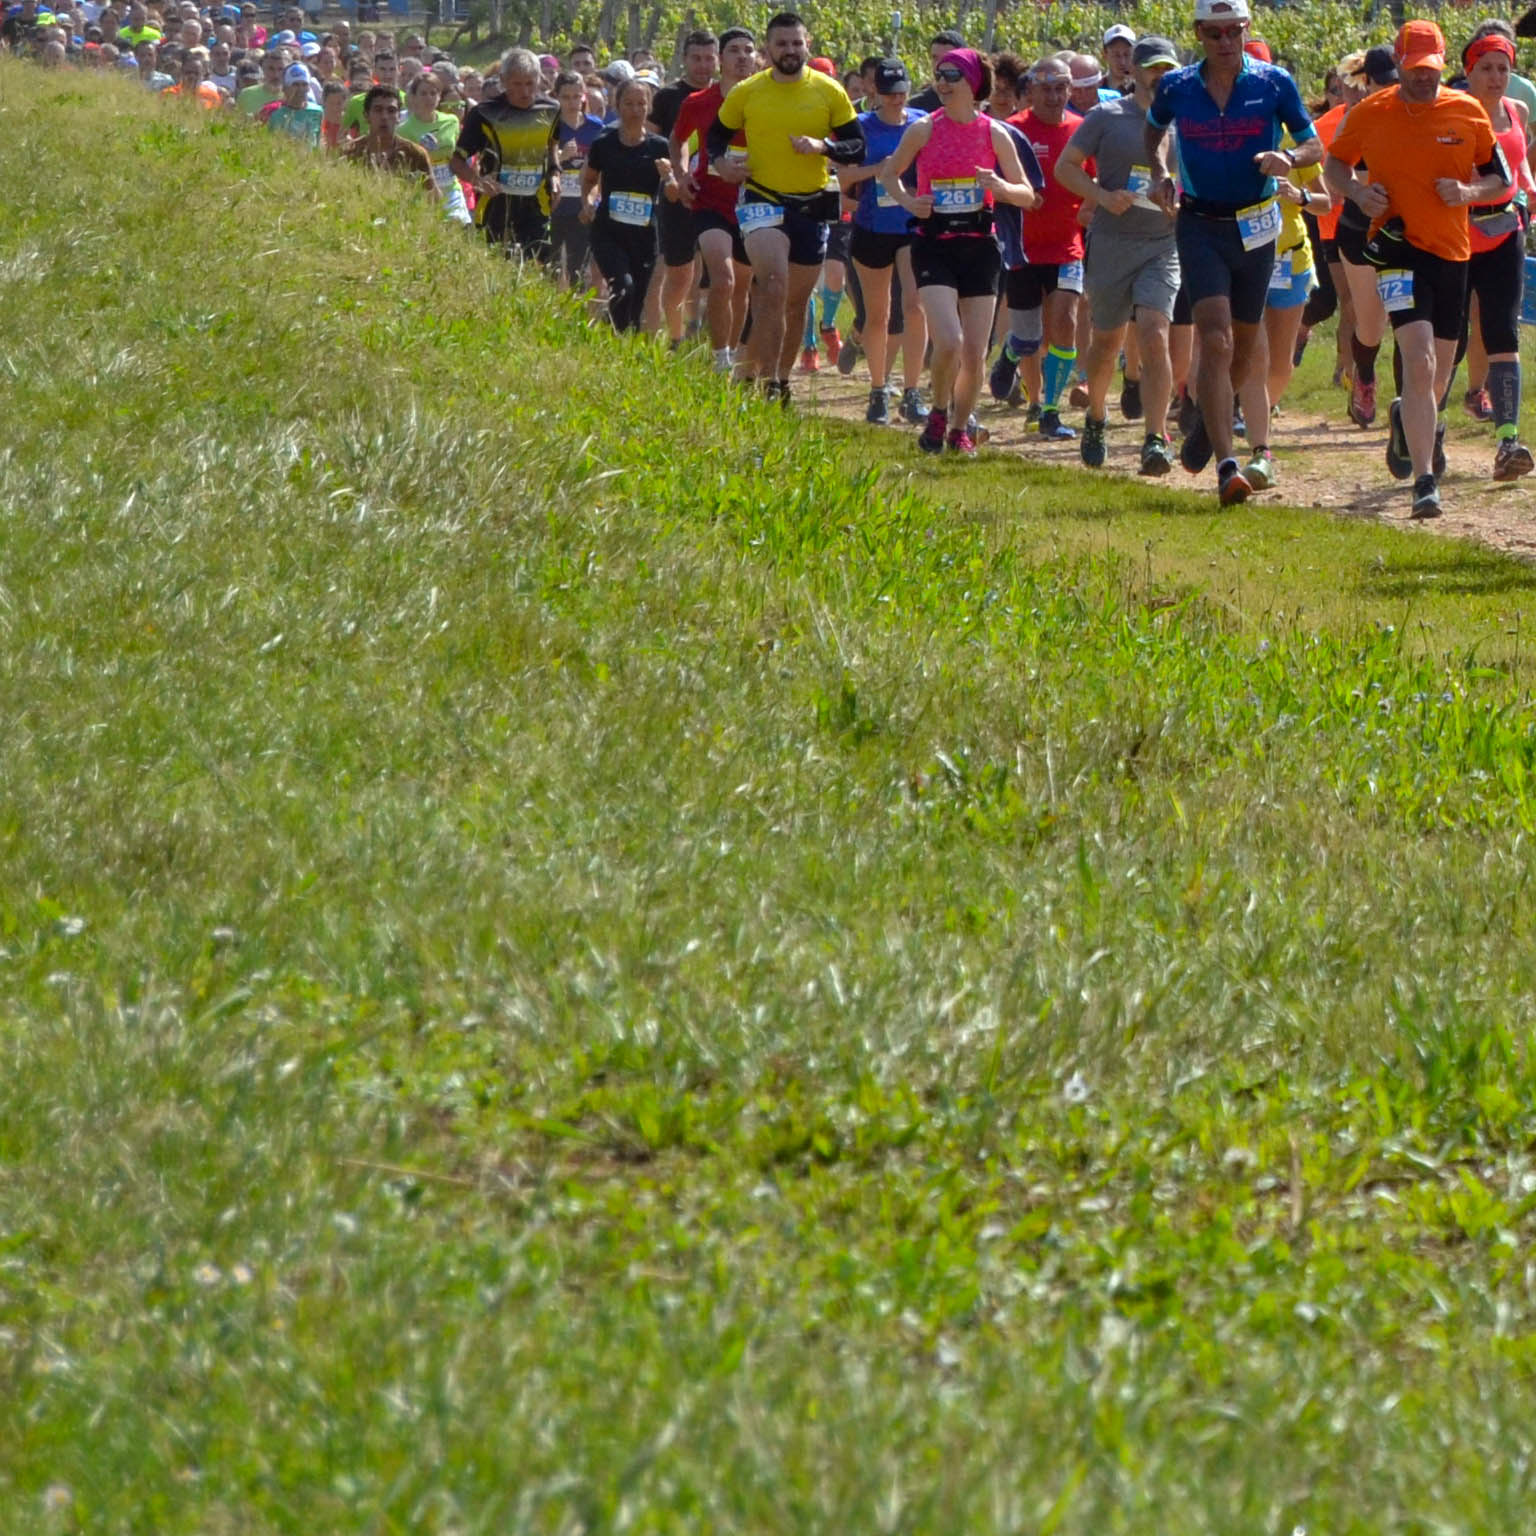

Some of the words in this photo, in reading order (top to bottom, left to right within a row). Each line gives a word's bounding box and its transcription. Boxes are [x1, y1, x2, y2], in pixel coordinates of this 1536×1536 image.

[941, 190, 976, 205] 261
[616, 200, 645, 216] 535
[1377, 281, 1403, 301] 72
